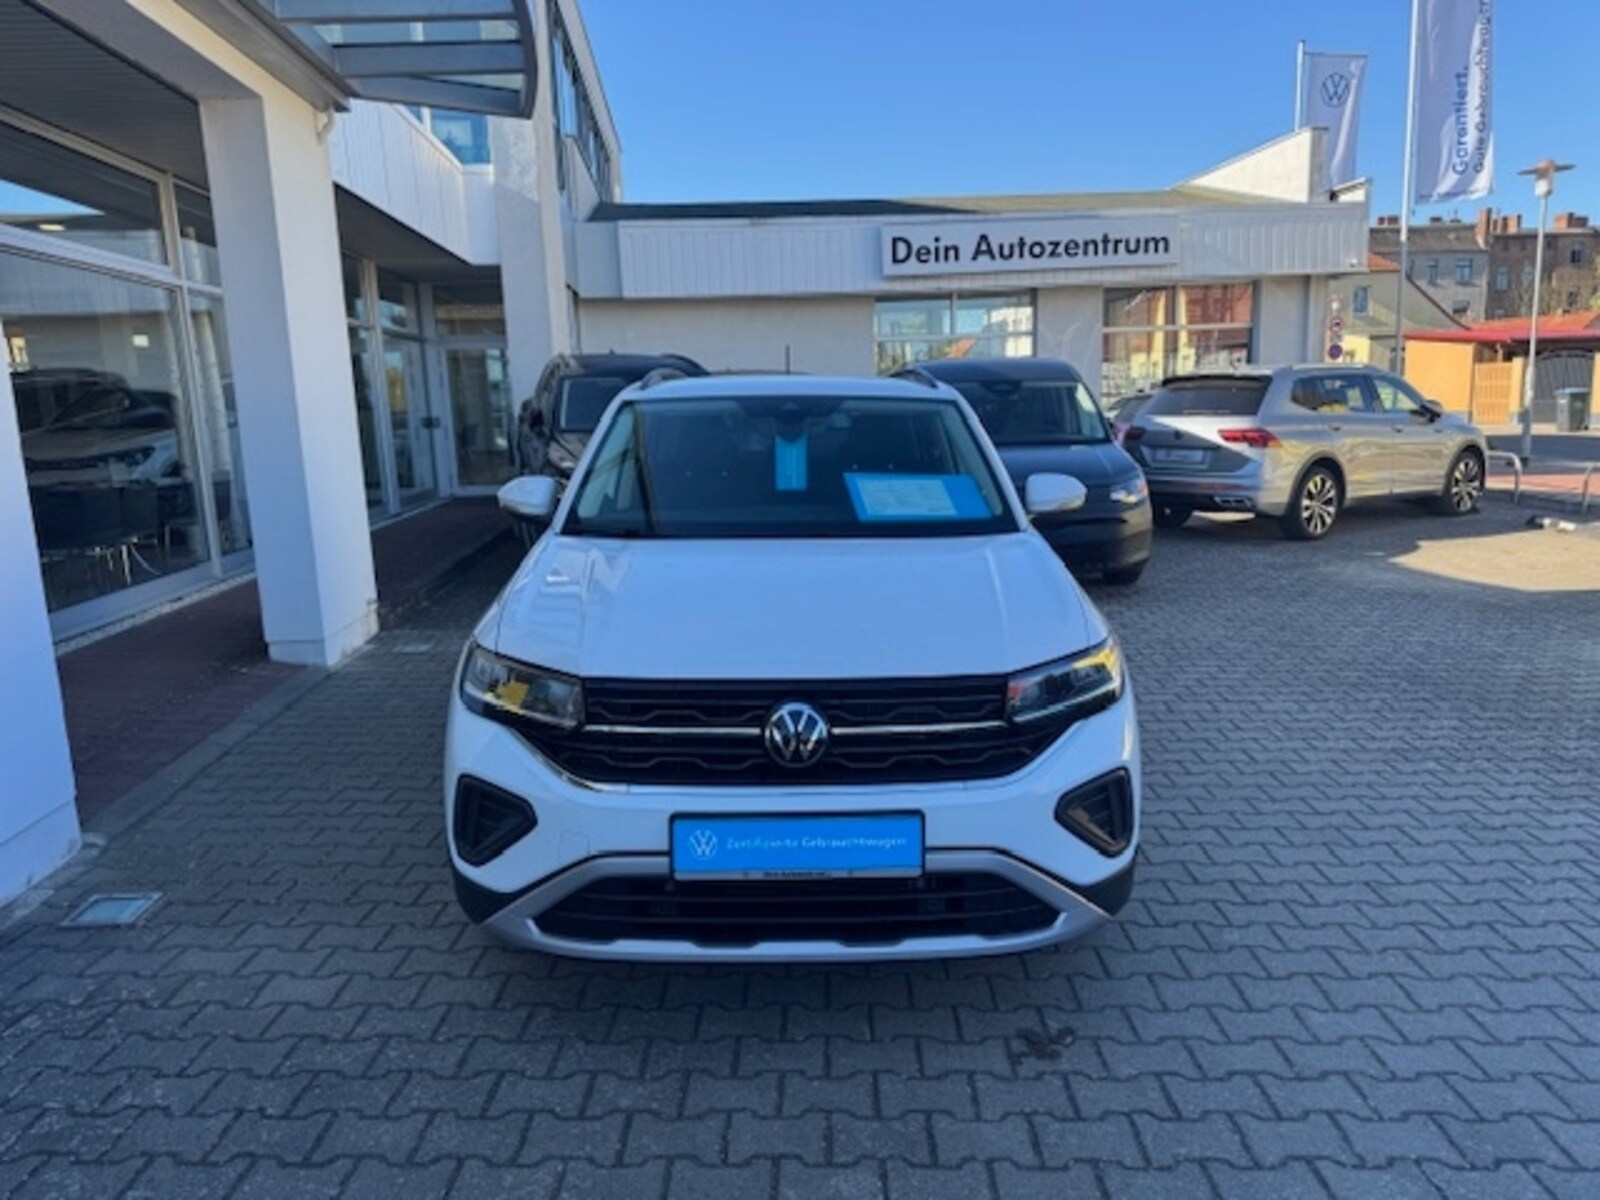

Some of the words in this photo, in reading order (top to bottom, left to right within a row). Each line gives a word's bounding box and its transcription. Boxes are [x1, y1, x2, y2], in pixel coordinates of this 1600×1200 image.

[1321, 72, 1350, 108] VW
[1452, 65, 1469, 175] Garantiert.
[1473, 136, 1487, 174] Gute
[891, 236, 960, 264] Dein
[971, 232, 1170, 262] Autozentrum
[764, 701, 828, 768] VW
